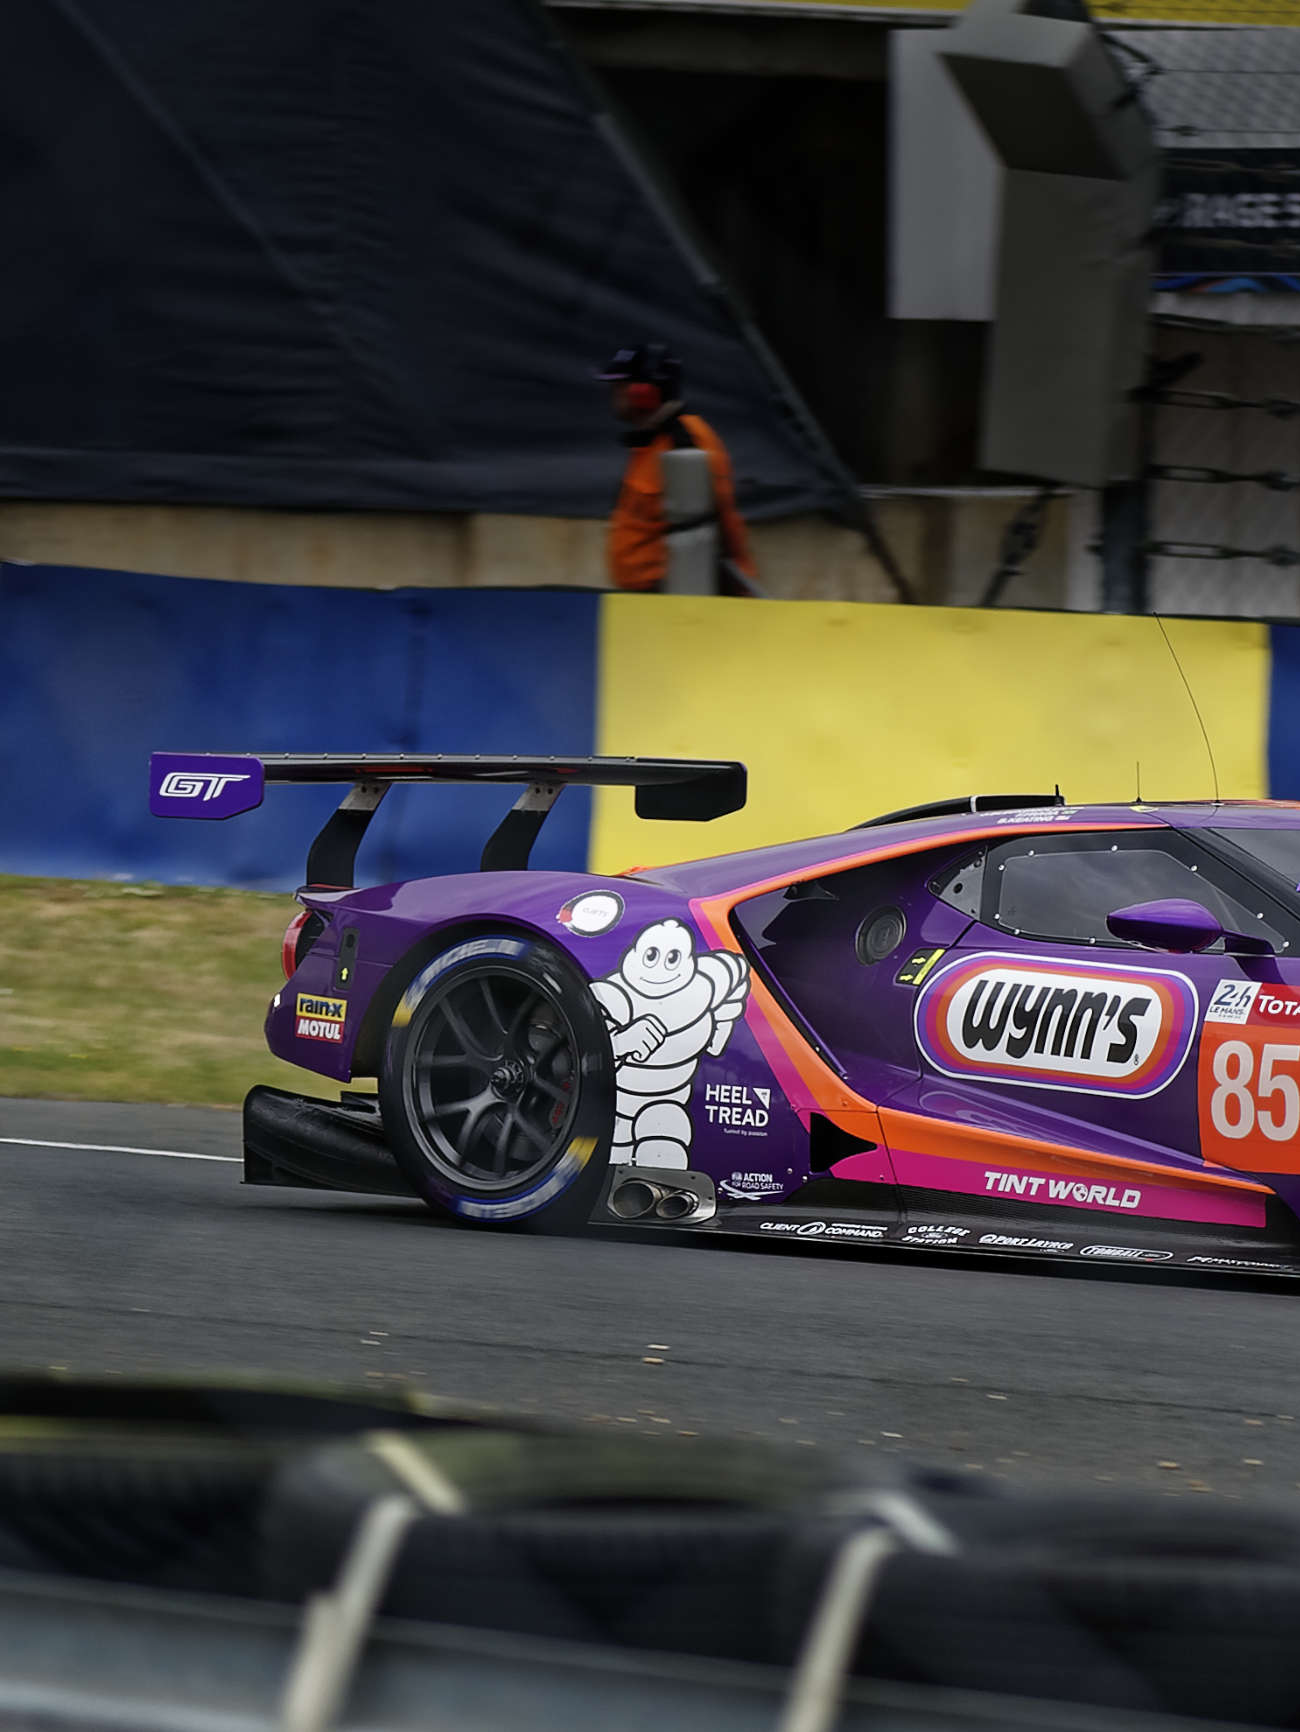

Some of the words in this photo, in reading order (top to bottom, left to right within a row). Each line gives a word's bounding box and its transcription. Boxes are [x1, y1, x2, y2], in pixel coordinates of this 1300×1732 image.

[159, 772, 251, 801] GT
[297, 1018, 341, 1040] MOTUL
[705, 1083, 752, 1105] HEEL
[1210, 1039, 1300, 1142] 85
[704, 1104, 769, 1127] TREAD
[743, 1172, 773, 1182] ACTION
[760, 1182, 784, 1190] SAFETY
[984, 1171, 1046, 1196] TINT
[1048, 1179, 1142, 1209] WORLD
